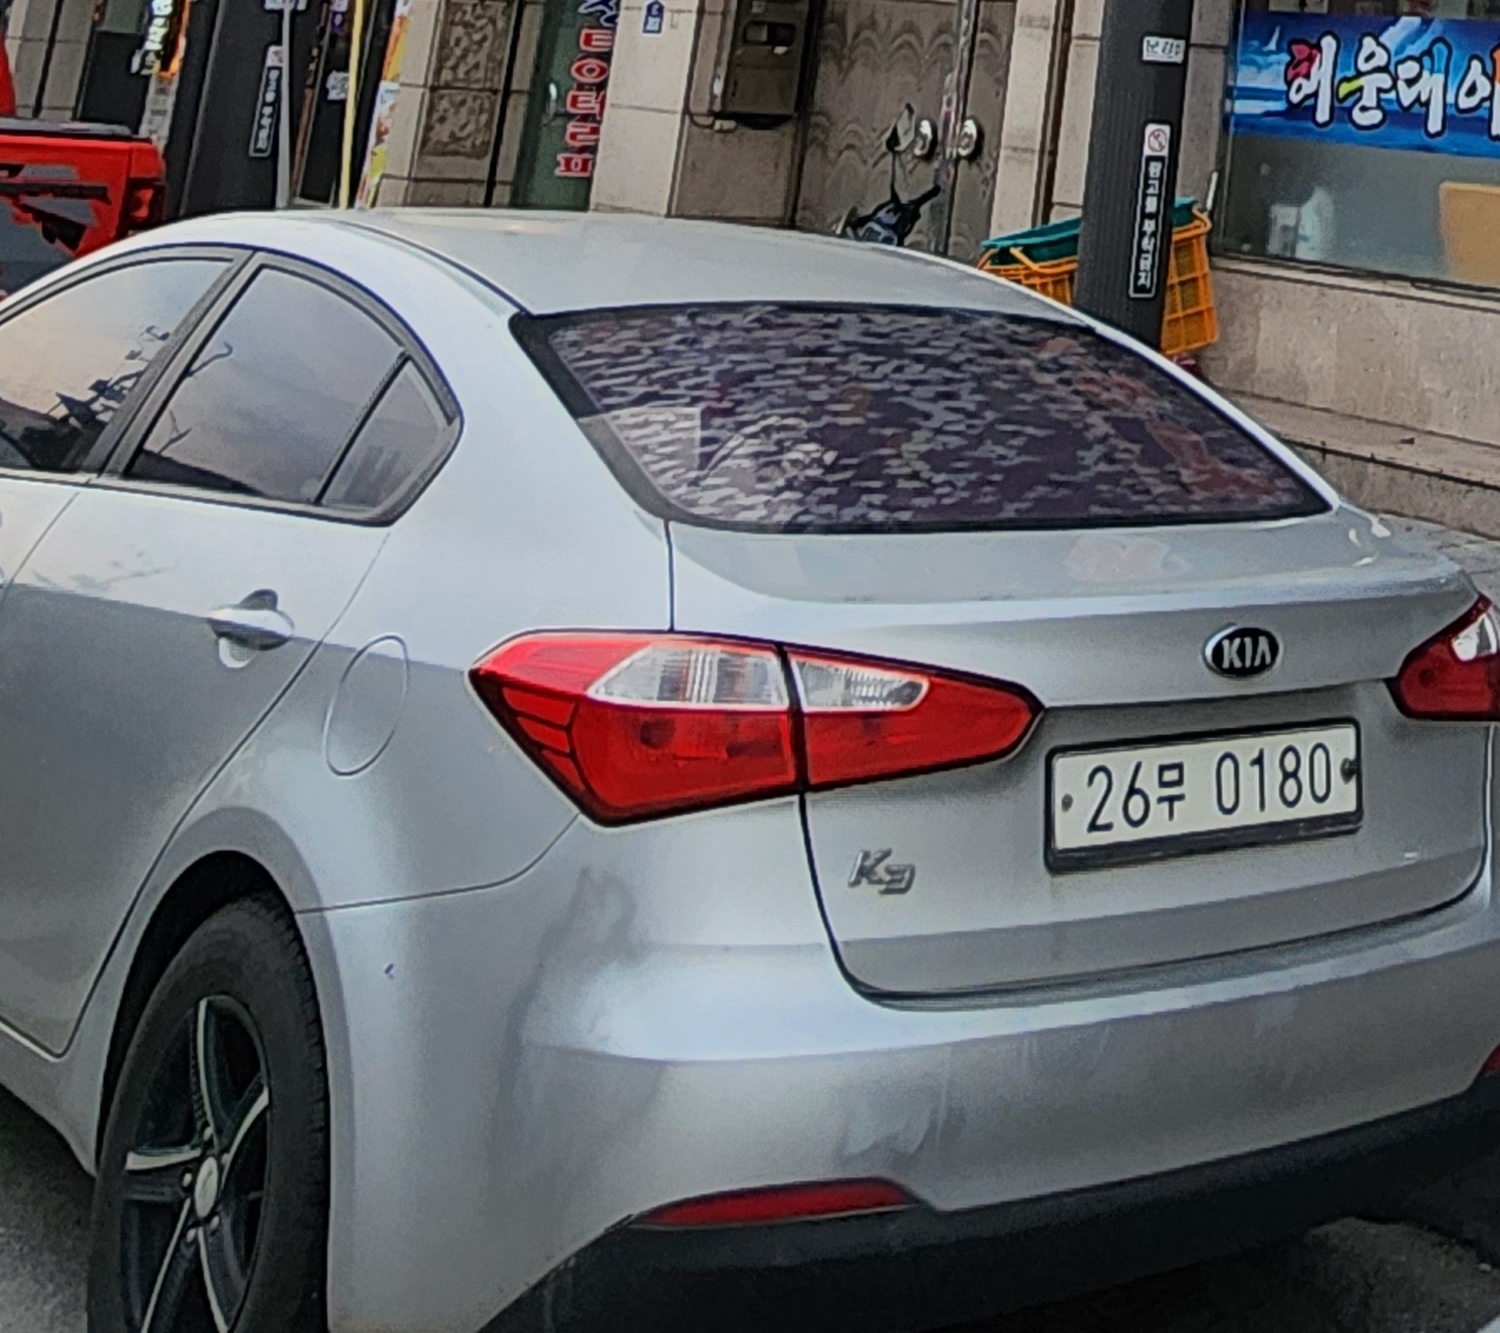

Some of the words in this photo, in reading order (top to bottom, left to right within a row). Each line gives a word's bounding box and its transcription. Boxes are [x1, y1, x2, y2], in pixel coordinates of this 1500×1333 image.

[1220, 636, 1273, 671] KIA
[1084, 760, 1187, 834] 26무
[1214, 739, 1334, 817] 0180
